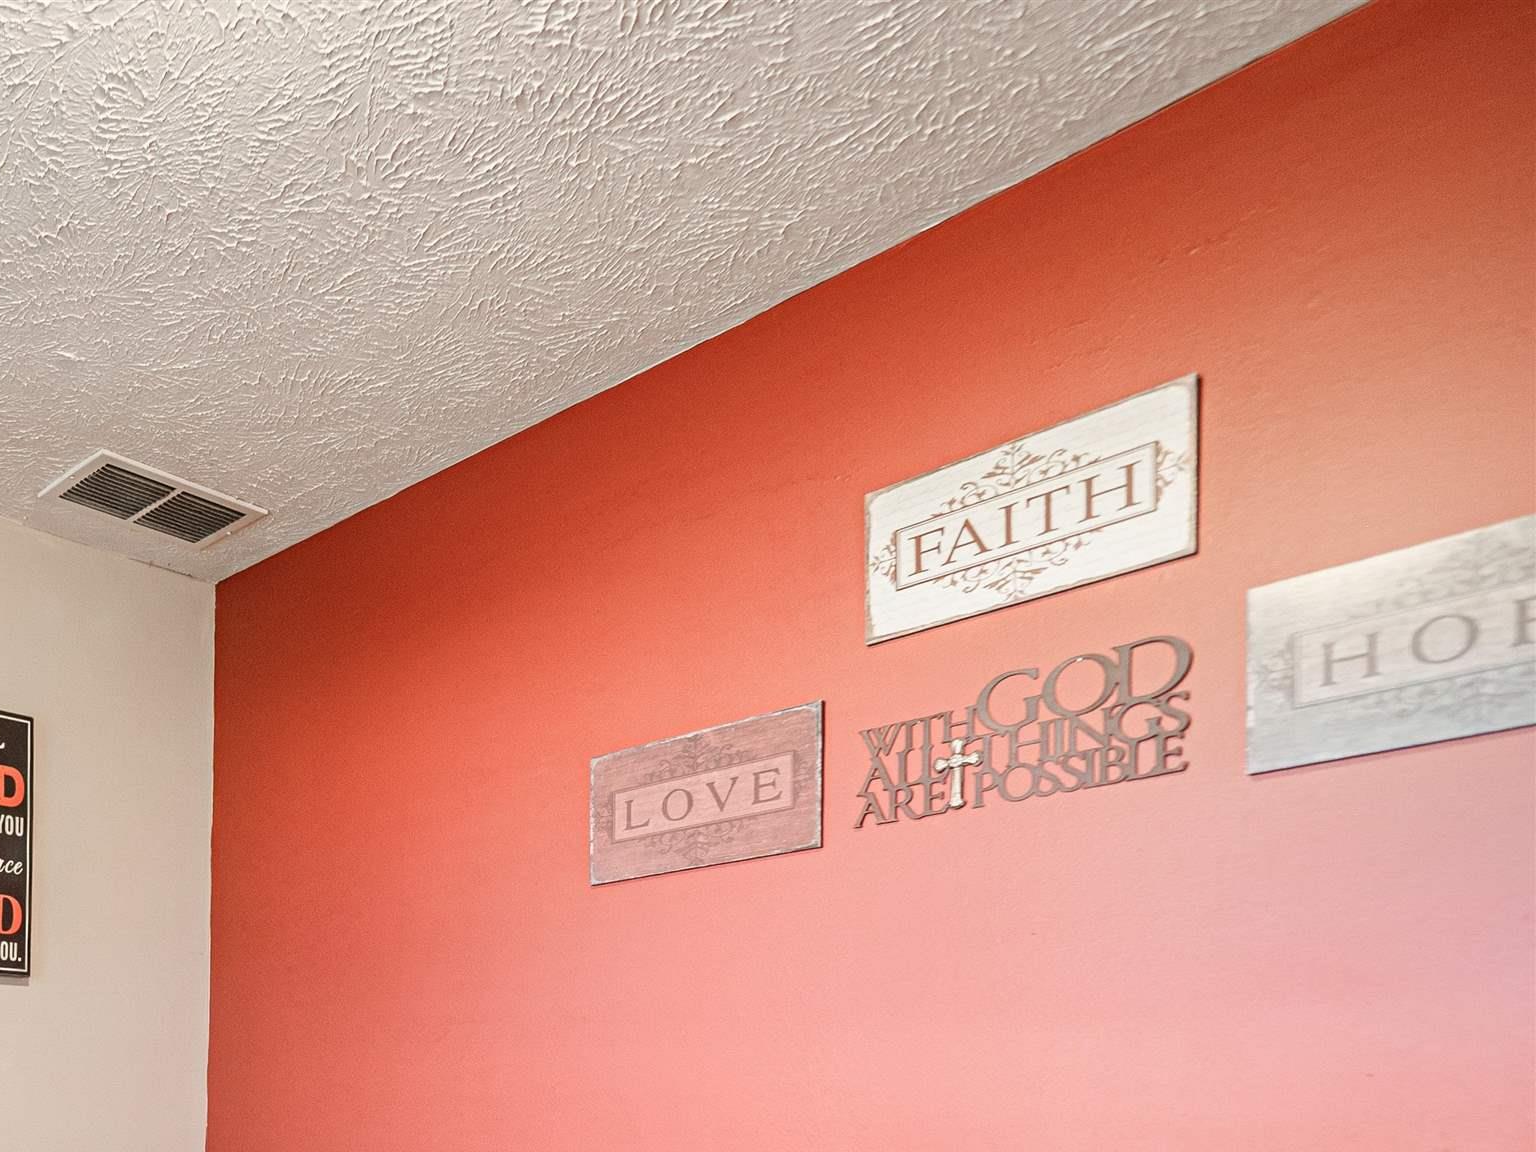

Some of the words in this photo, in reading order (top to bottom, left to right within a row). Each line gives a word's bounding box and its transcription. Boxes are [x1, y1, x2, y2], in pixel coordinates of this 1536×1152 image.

[907, 460, 1144, 576] FAITH
[857, 744, 949, 797] ALL
[963, 690, 1192, 768] THINGS
[858, 704, 979, 757] WITH
[976, 635, 1194, 734] GOD
[623, 767, 784, 832] LOVE
[853, 783, 951, 829] ARE
[971, 733, 1190, 809] POSSIBLE
